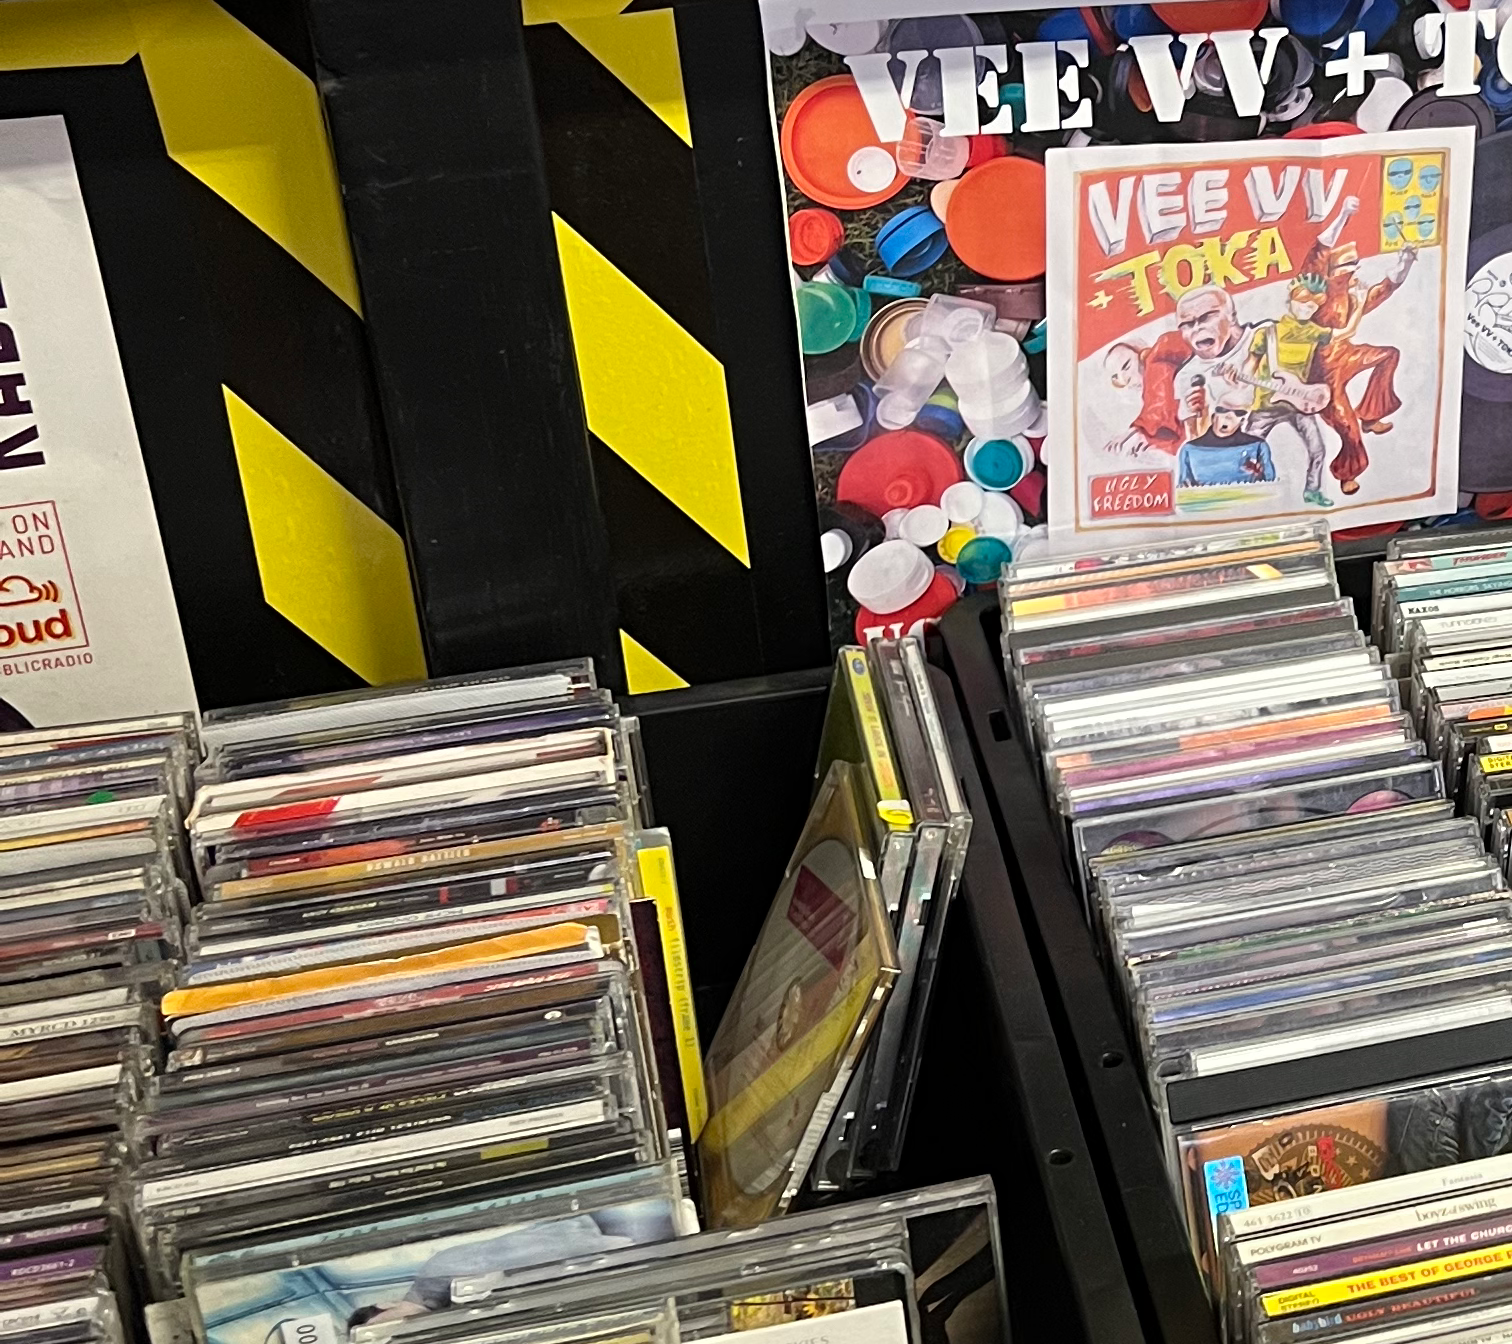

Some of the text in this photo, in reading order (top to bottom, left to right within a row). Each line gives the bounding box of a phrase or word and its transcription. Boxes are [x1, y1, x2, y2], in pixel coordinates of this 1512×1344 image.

[844, 39, 1094, 143] VEE
[1126, 27, 1290, 123] VV
[1325, 32, 1389, 98] +
[1088, 169, 1230, 257] VEE
[1090, 227, 1293, 317] TOKA
[1105, 473, 1159, 492] UGLY
[1093, 492, 1170, 511] FREEDOM
[12, 514, 50, 533] ON
[1407, 604, 1440, 616] NAXOS
[0, 652, 94, 676] BLICRADIO
[1250, 1238, 1308, 1258] POLYGRAM
[1416, 1240, 1438, 1252] LET
[1443, 1233, 1468, 1247] THE
[1347, 1281, 1376, 1295] THE
[1379, 1271, 1417, 1287] BEST
[1420, 1265, 1440, 1279] OF
[1444, 1251, 1503, 1273] GEORGE
